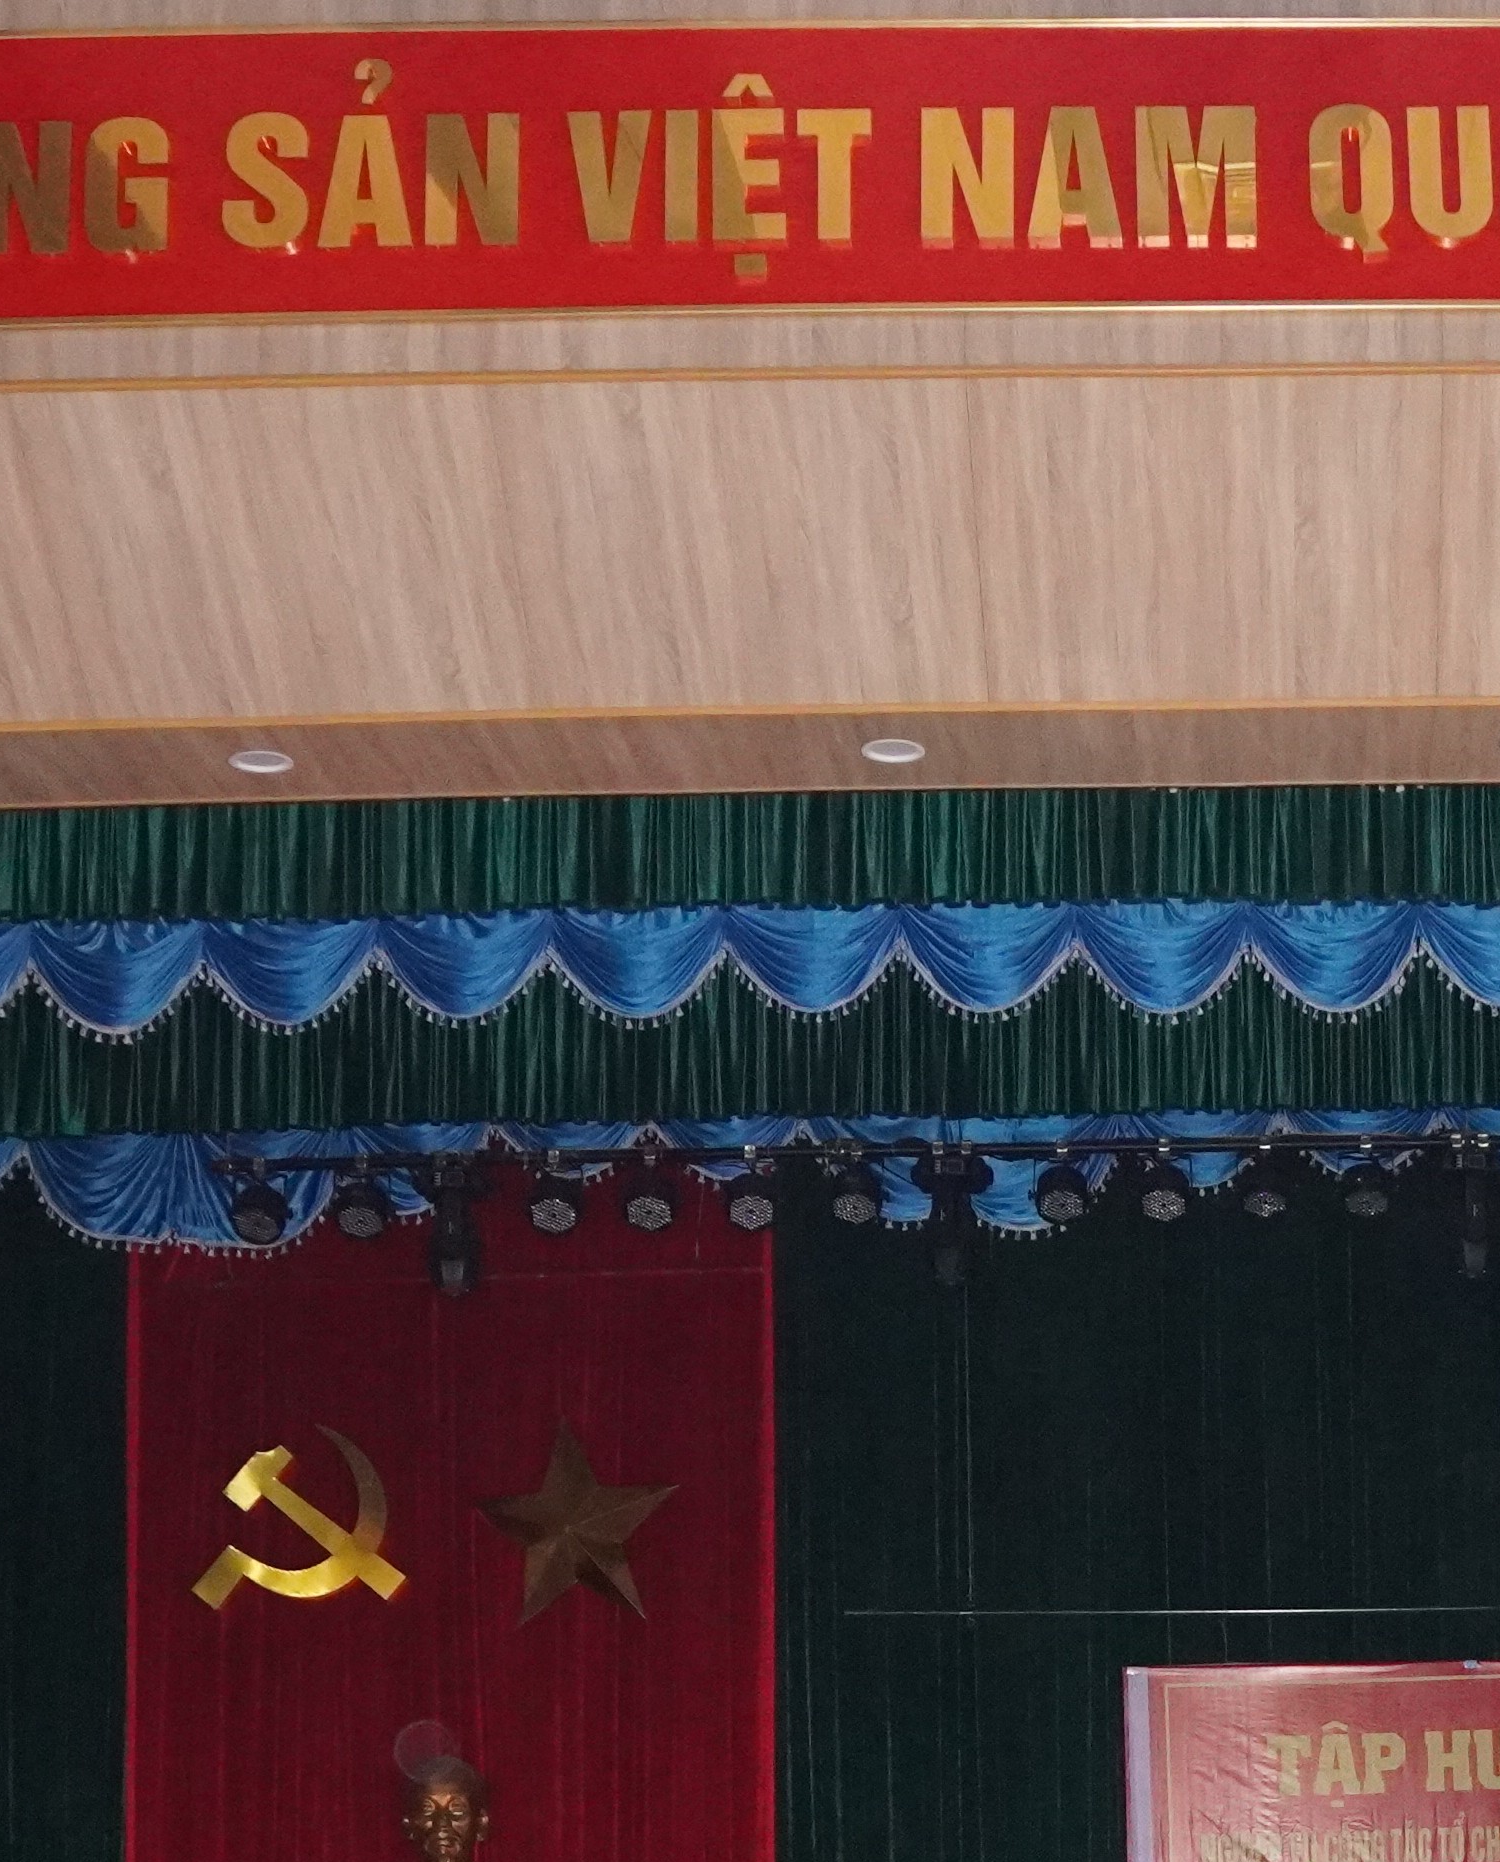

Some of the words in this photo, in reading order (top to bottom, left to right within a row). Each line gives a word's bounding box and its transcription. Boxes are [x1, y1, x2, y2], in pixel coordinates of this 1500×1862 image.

[221, 58, 520, 251] SẢN
[567, 73, 873, 282] VIỆT
[919, 105, 1258, 249] NAM
[1267, 1721, 1407, 1808] TẬP
